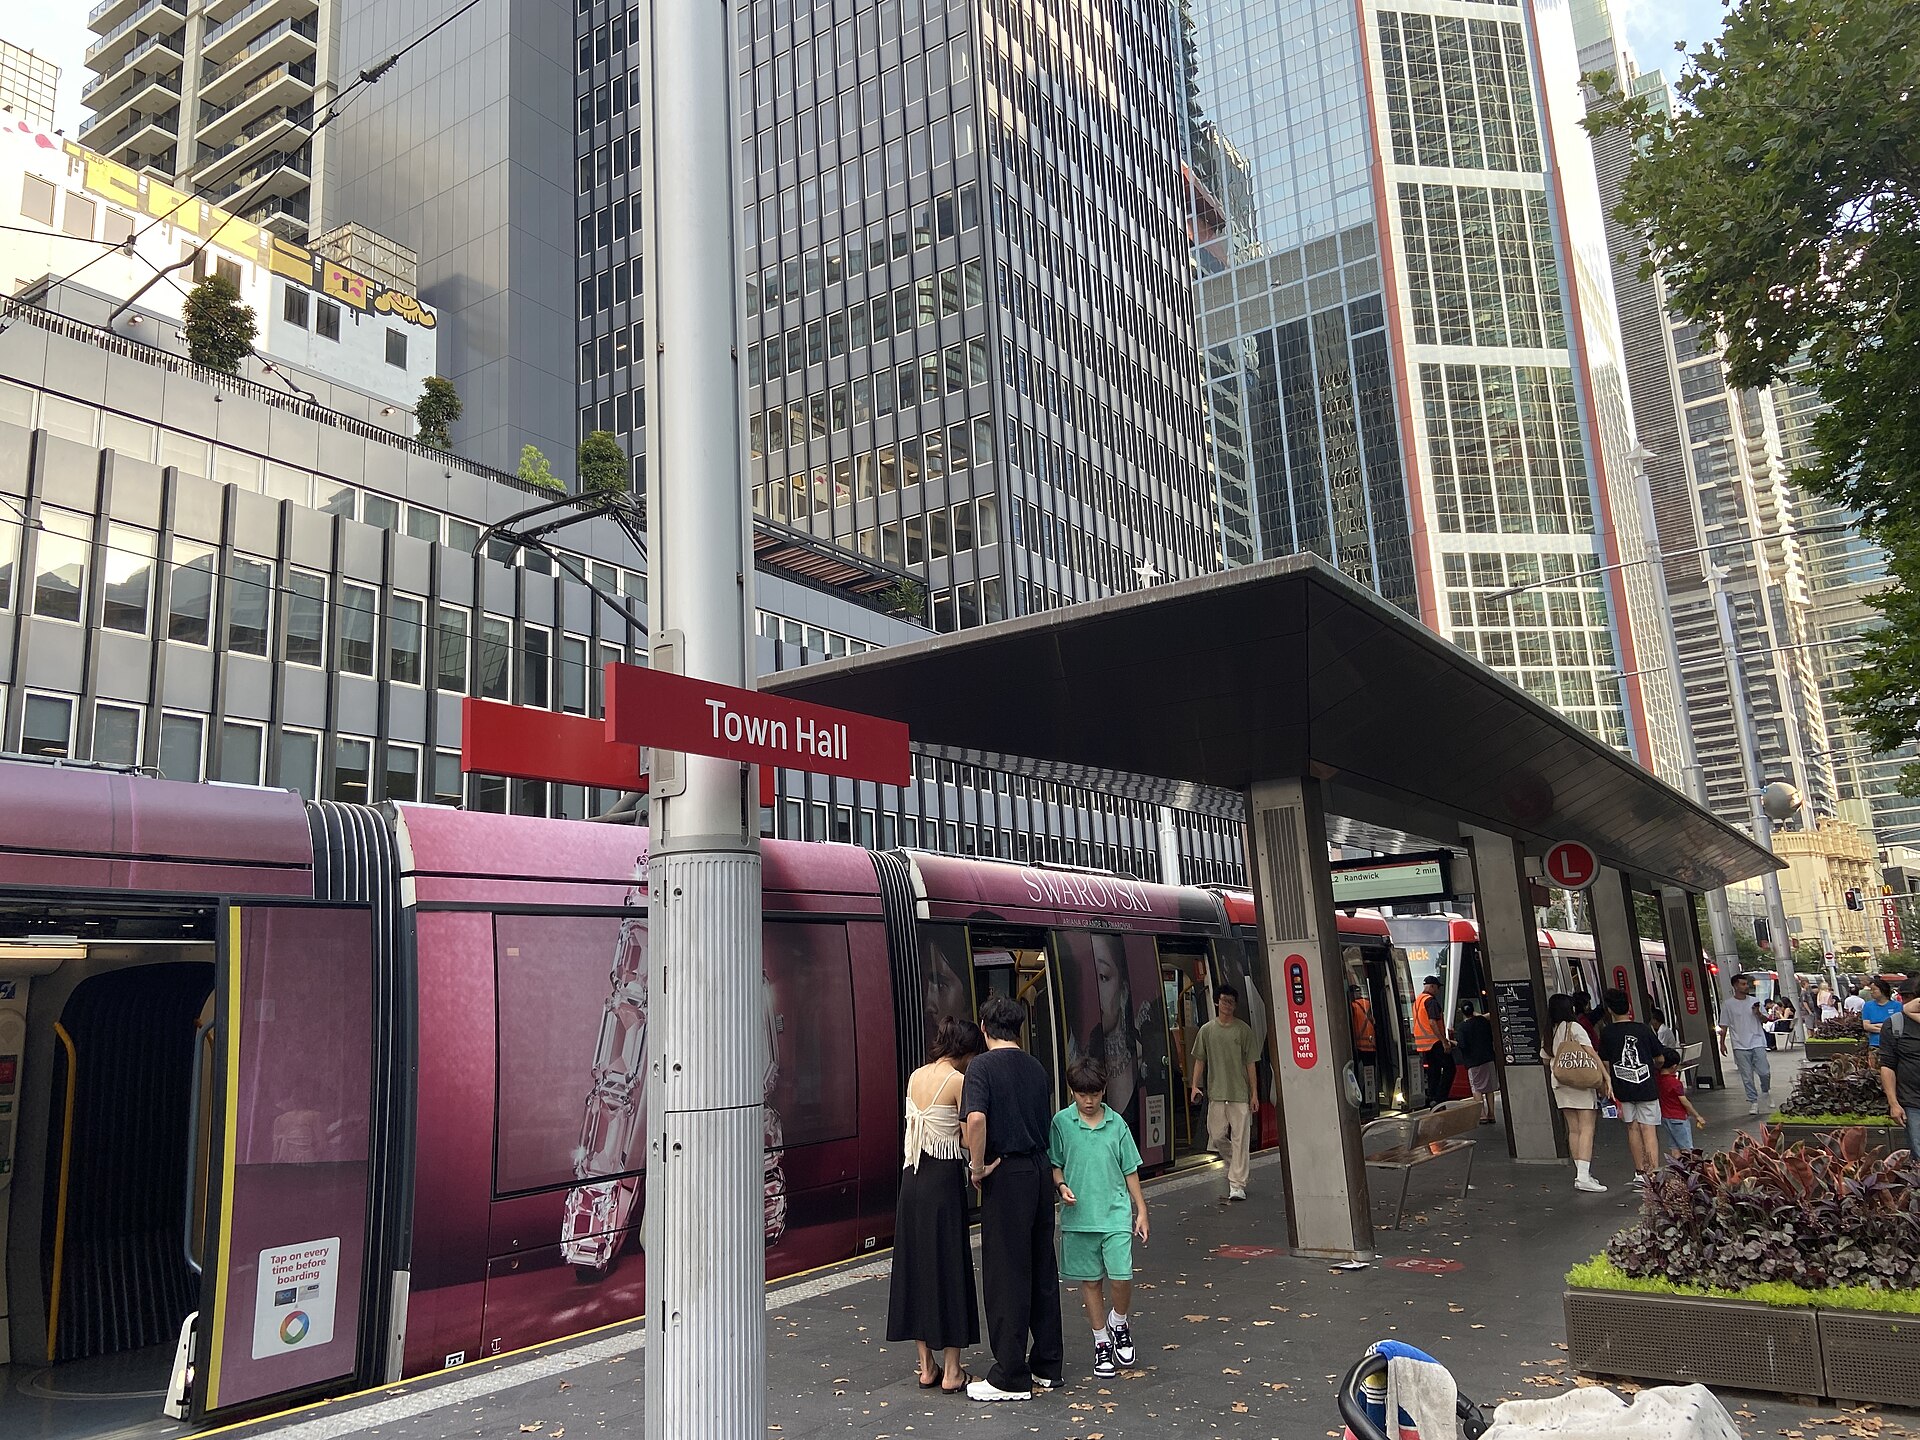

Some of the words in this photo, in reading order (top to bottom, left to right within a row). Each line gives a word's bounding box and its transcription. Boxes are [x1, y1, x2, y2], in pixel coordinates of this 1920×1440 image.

[705, 699, 787, 750] Town
[796, 717, 847, 760] Hall
[1561, 851, 1581, 878] L
[1344, 872, 1379, 882] Randwick
[1415, 867, 1421, 875] 2
[1422, 866, 1437, 874] min
[1021, 868, 1152, 912] SWAROVSKI
[1294, 1011, 1308, 1019] Tap
[1559, 1051, 1594, 1060] GENTL
[1557, 1059, 1598, 1070] WOMAN
[271, 1256, 287, 1265] Tap
[289, 1253, 301, 1261] on
[304, 1248, 329, 1259] every
[272, 1266, 293, 1274] time
[296, 1259, 326, 1270] before
[277, 1270, 320, 1285] boarding
